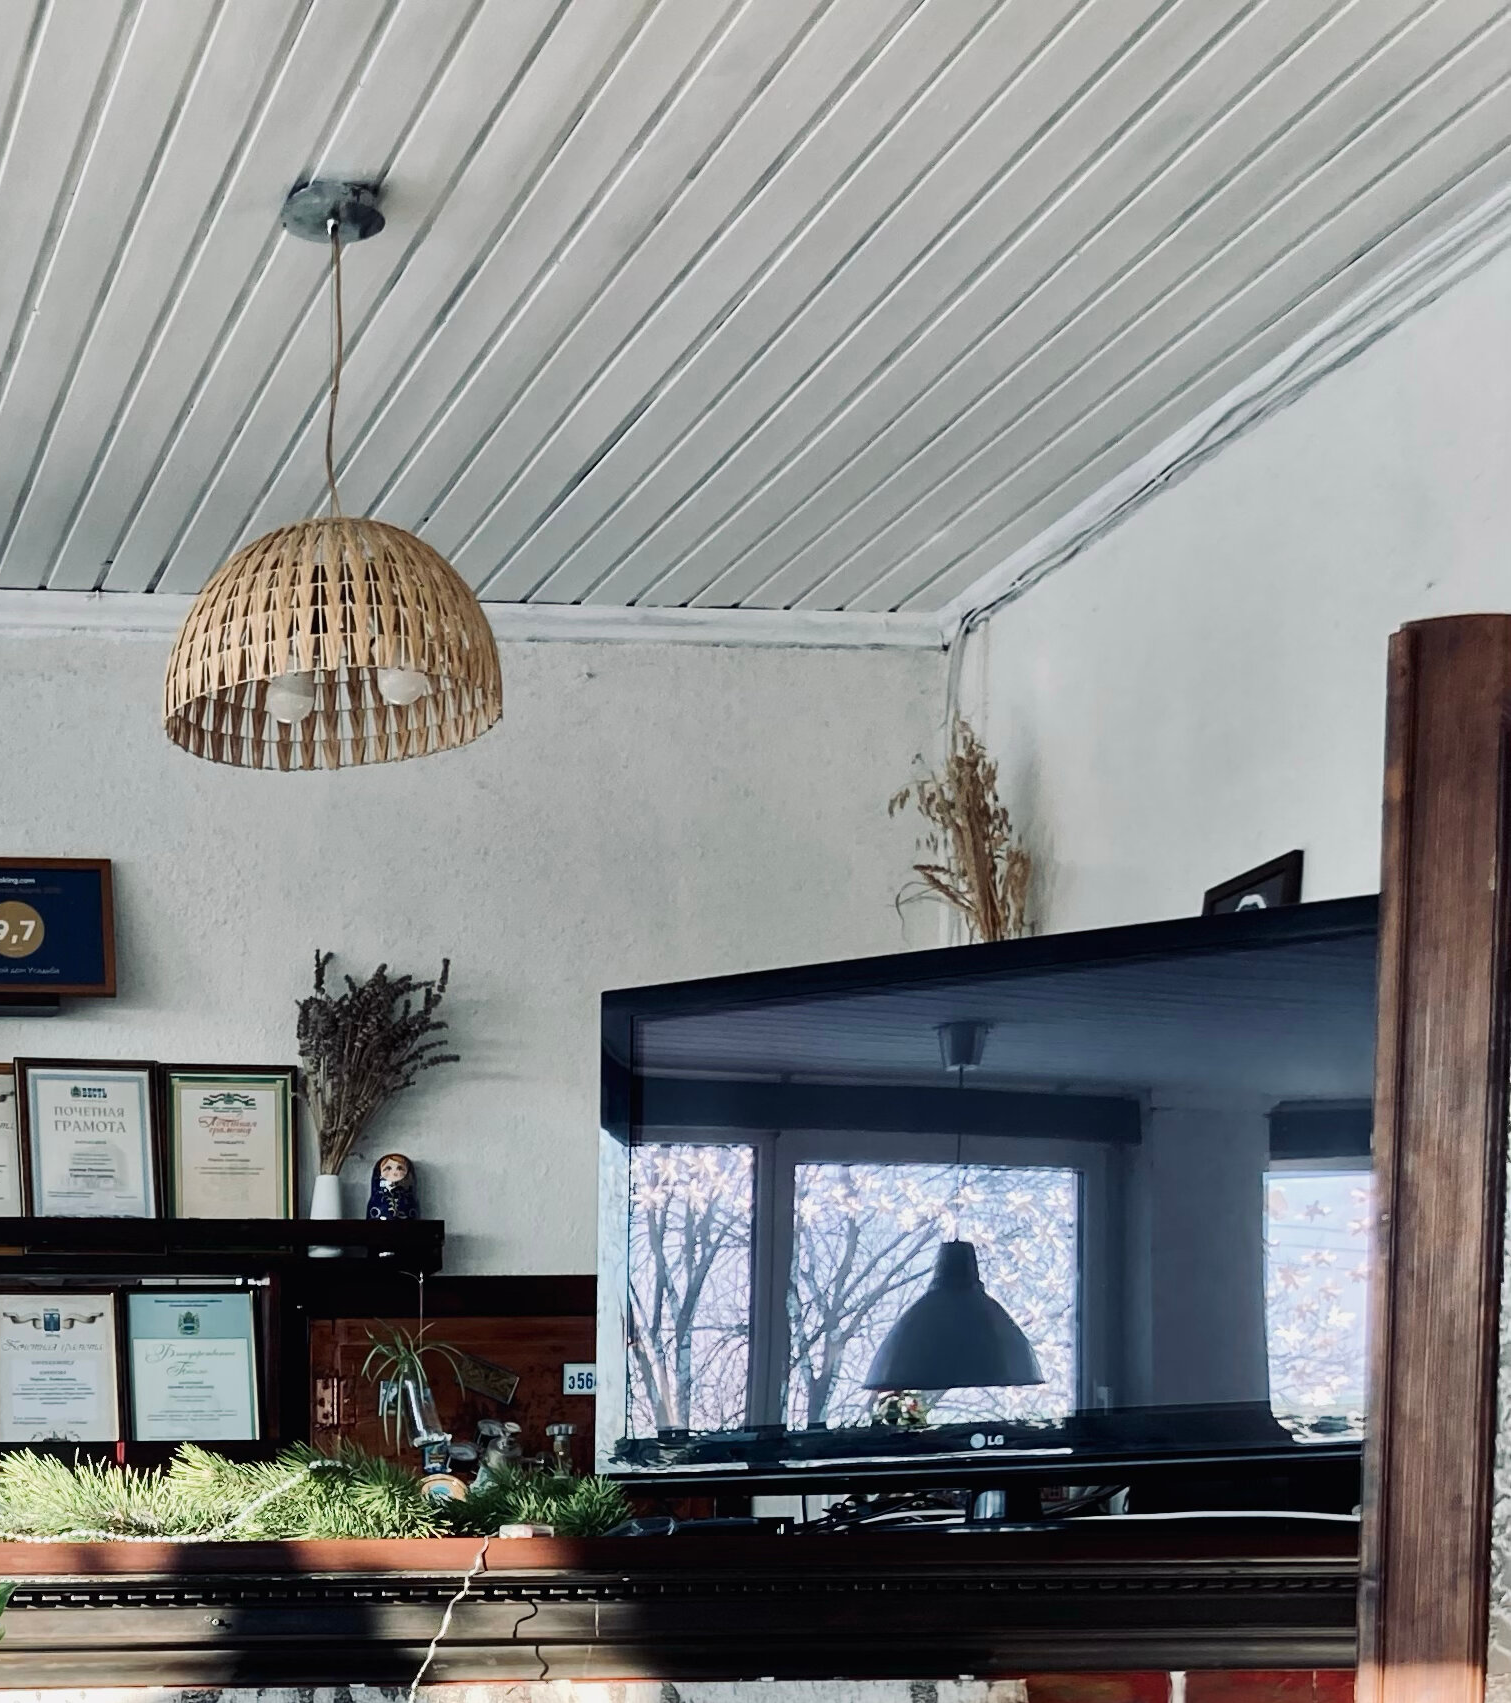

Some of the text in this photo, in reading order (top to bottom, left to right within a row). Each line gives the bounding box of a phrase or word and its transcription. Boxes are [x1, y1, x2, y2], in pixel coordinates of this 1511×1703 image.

[54, 1106, 125, 1118] ПОЧЕТНАЯ
[54, 1120, 127, 1133] ГРАМОТА
[987, 1434, 1004, 1446] LG
